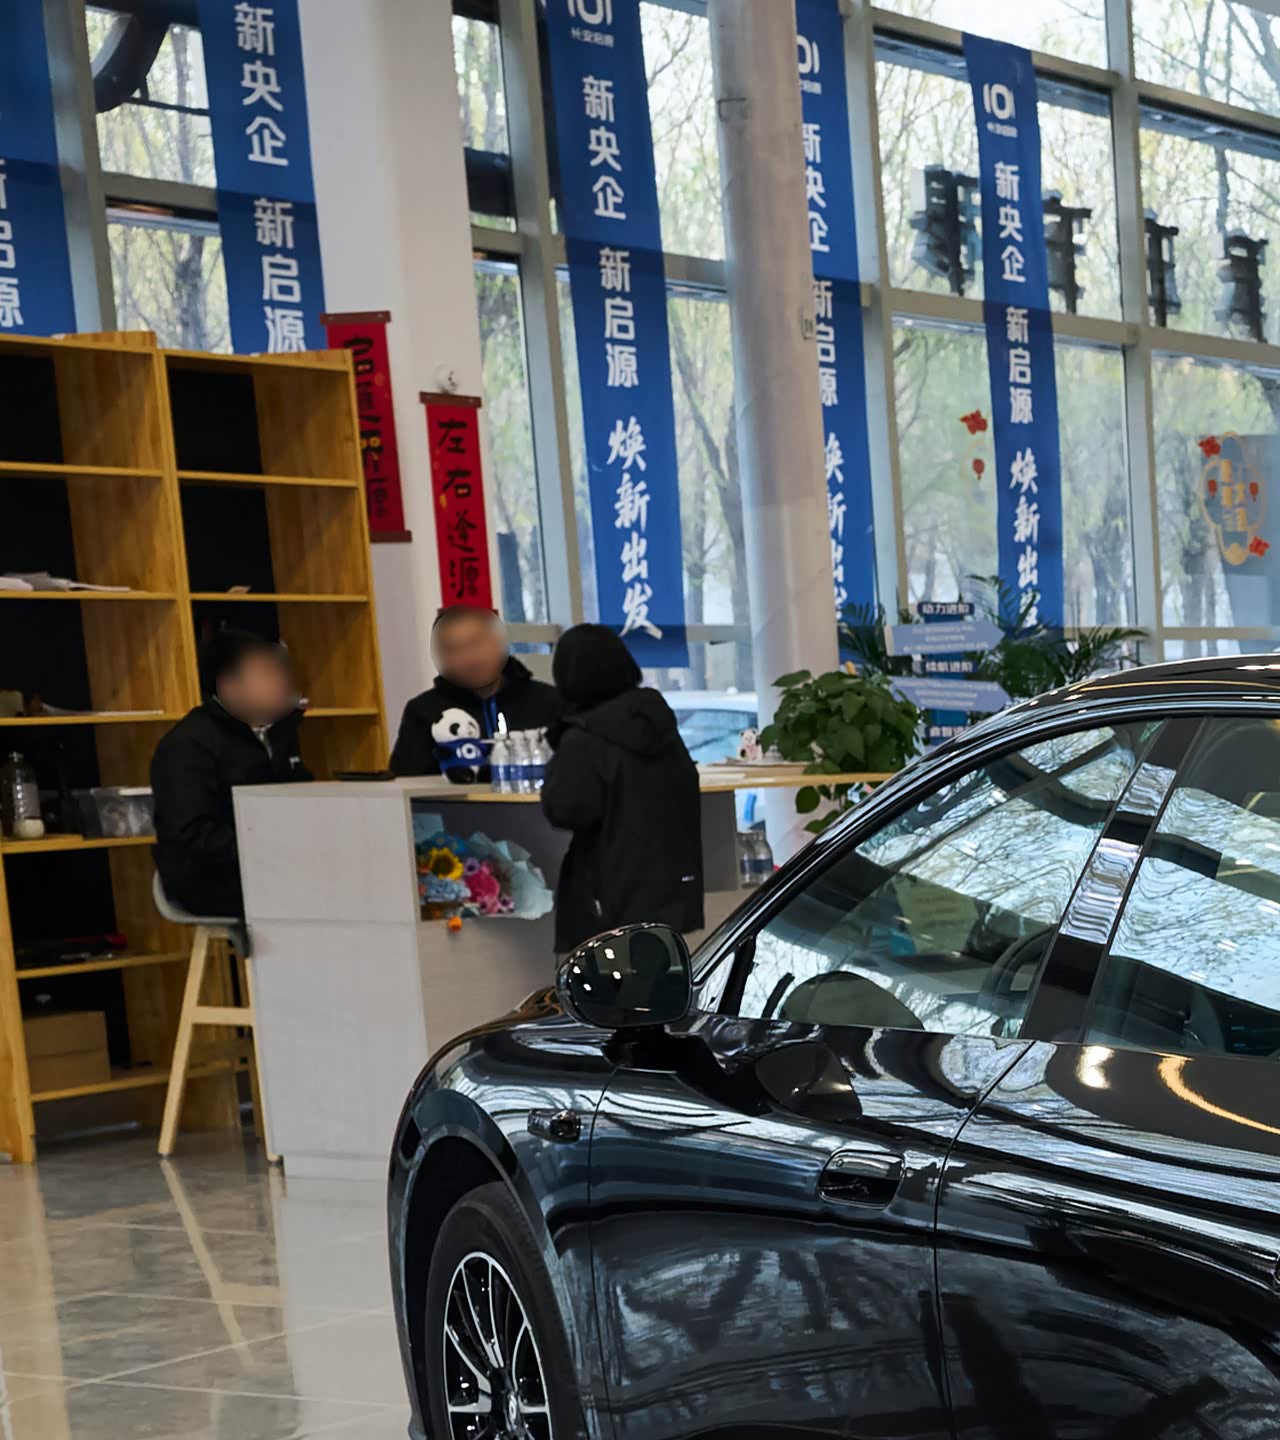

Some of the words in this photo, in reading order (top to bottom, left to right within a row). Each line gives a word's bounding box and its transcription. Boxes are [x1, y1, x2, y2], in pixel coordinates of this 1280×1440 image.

[233, 2, 289, 166] 新央企
[582, 75, 627, 220] 新央企
[253, 197, 307, 352] 新启源
[994, 161, 1026, 283] 新央企
[599, 246, 639, 388] 新启源
[1005, 305, 1034, 425] 新启源
[437, 417, 480, 599] 左右逢源
[606, 415, 662, 640] 焕新出发
[1009, 447, 1042, 629] 焕新出发
